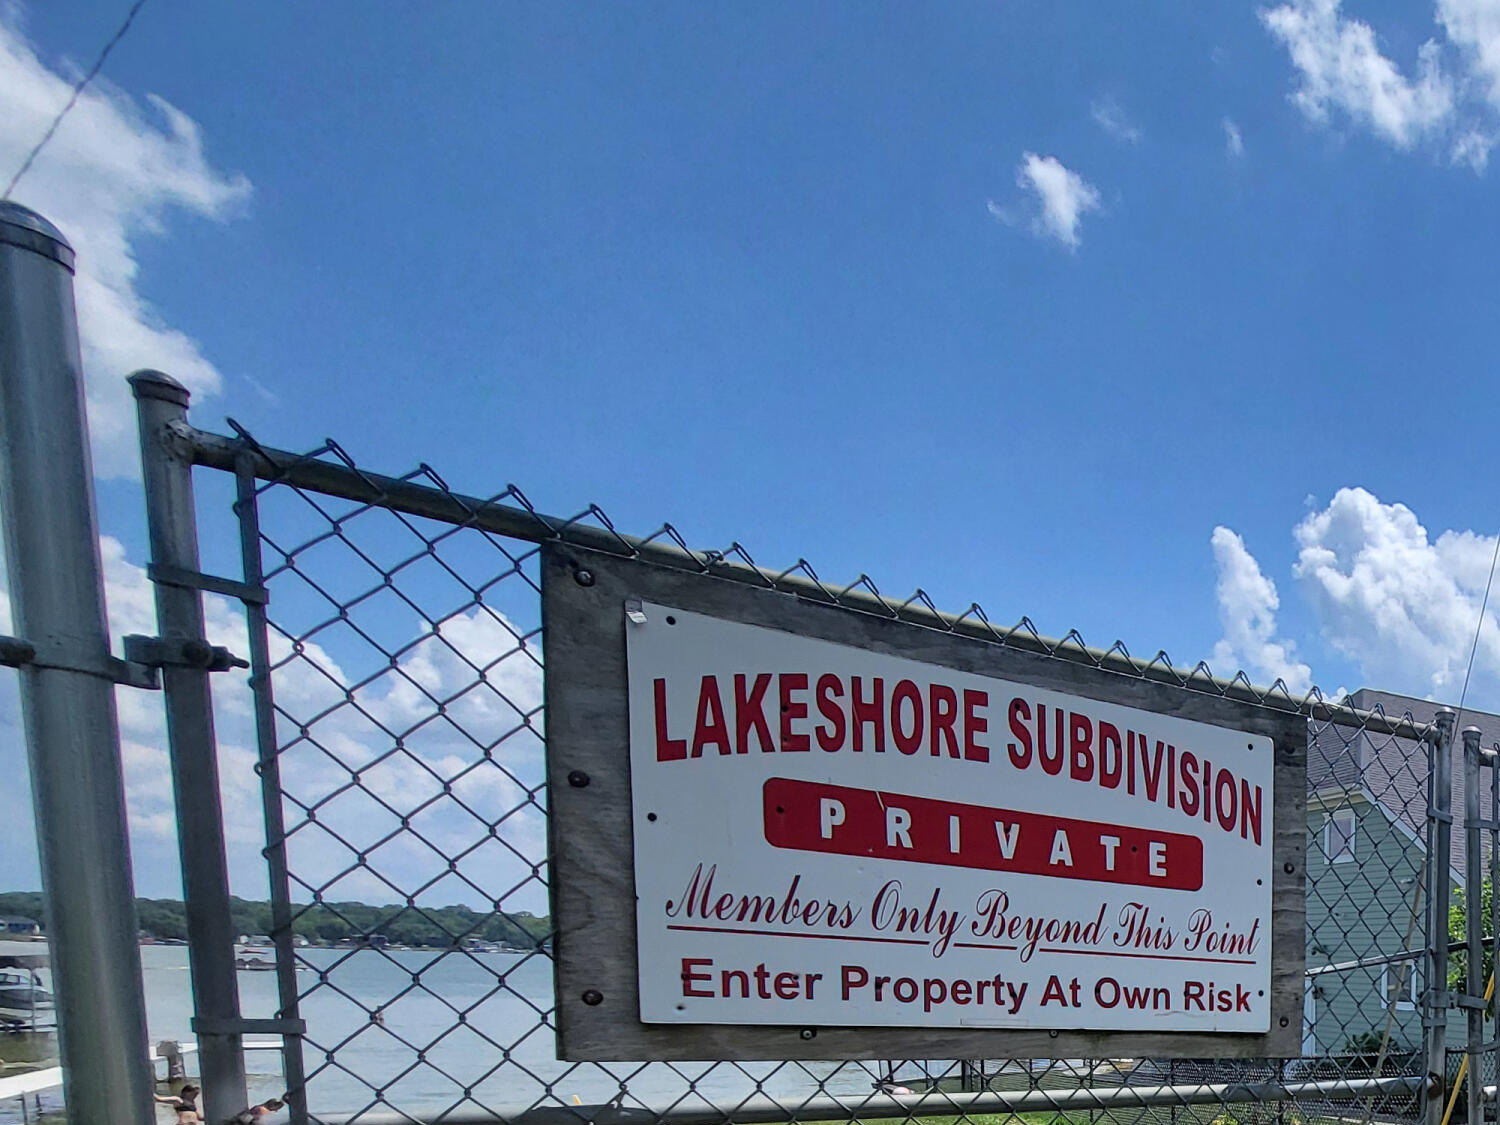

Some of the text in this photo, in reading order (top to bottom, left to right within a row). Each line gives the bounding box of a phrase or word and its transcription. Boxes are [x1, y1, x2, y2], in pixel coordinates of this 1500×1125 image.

[653, 673, 1263, 846] LAKESHORE SUBDIVISION
[820, 796, 1168, 878] PRIVATE
[666, 863, 1260, 962] Members Only Beyond This Point
[681, 957, 1252, 1015] Enter Property At Own Risk
